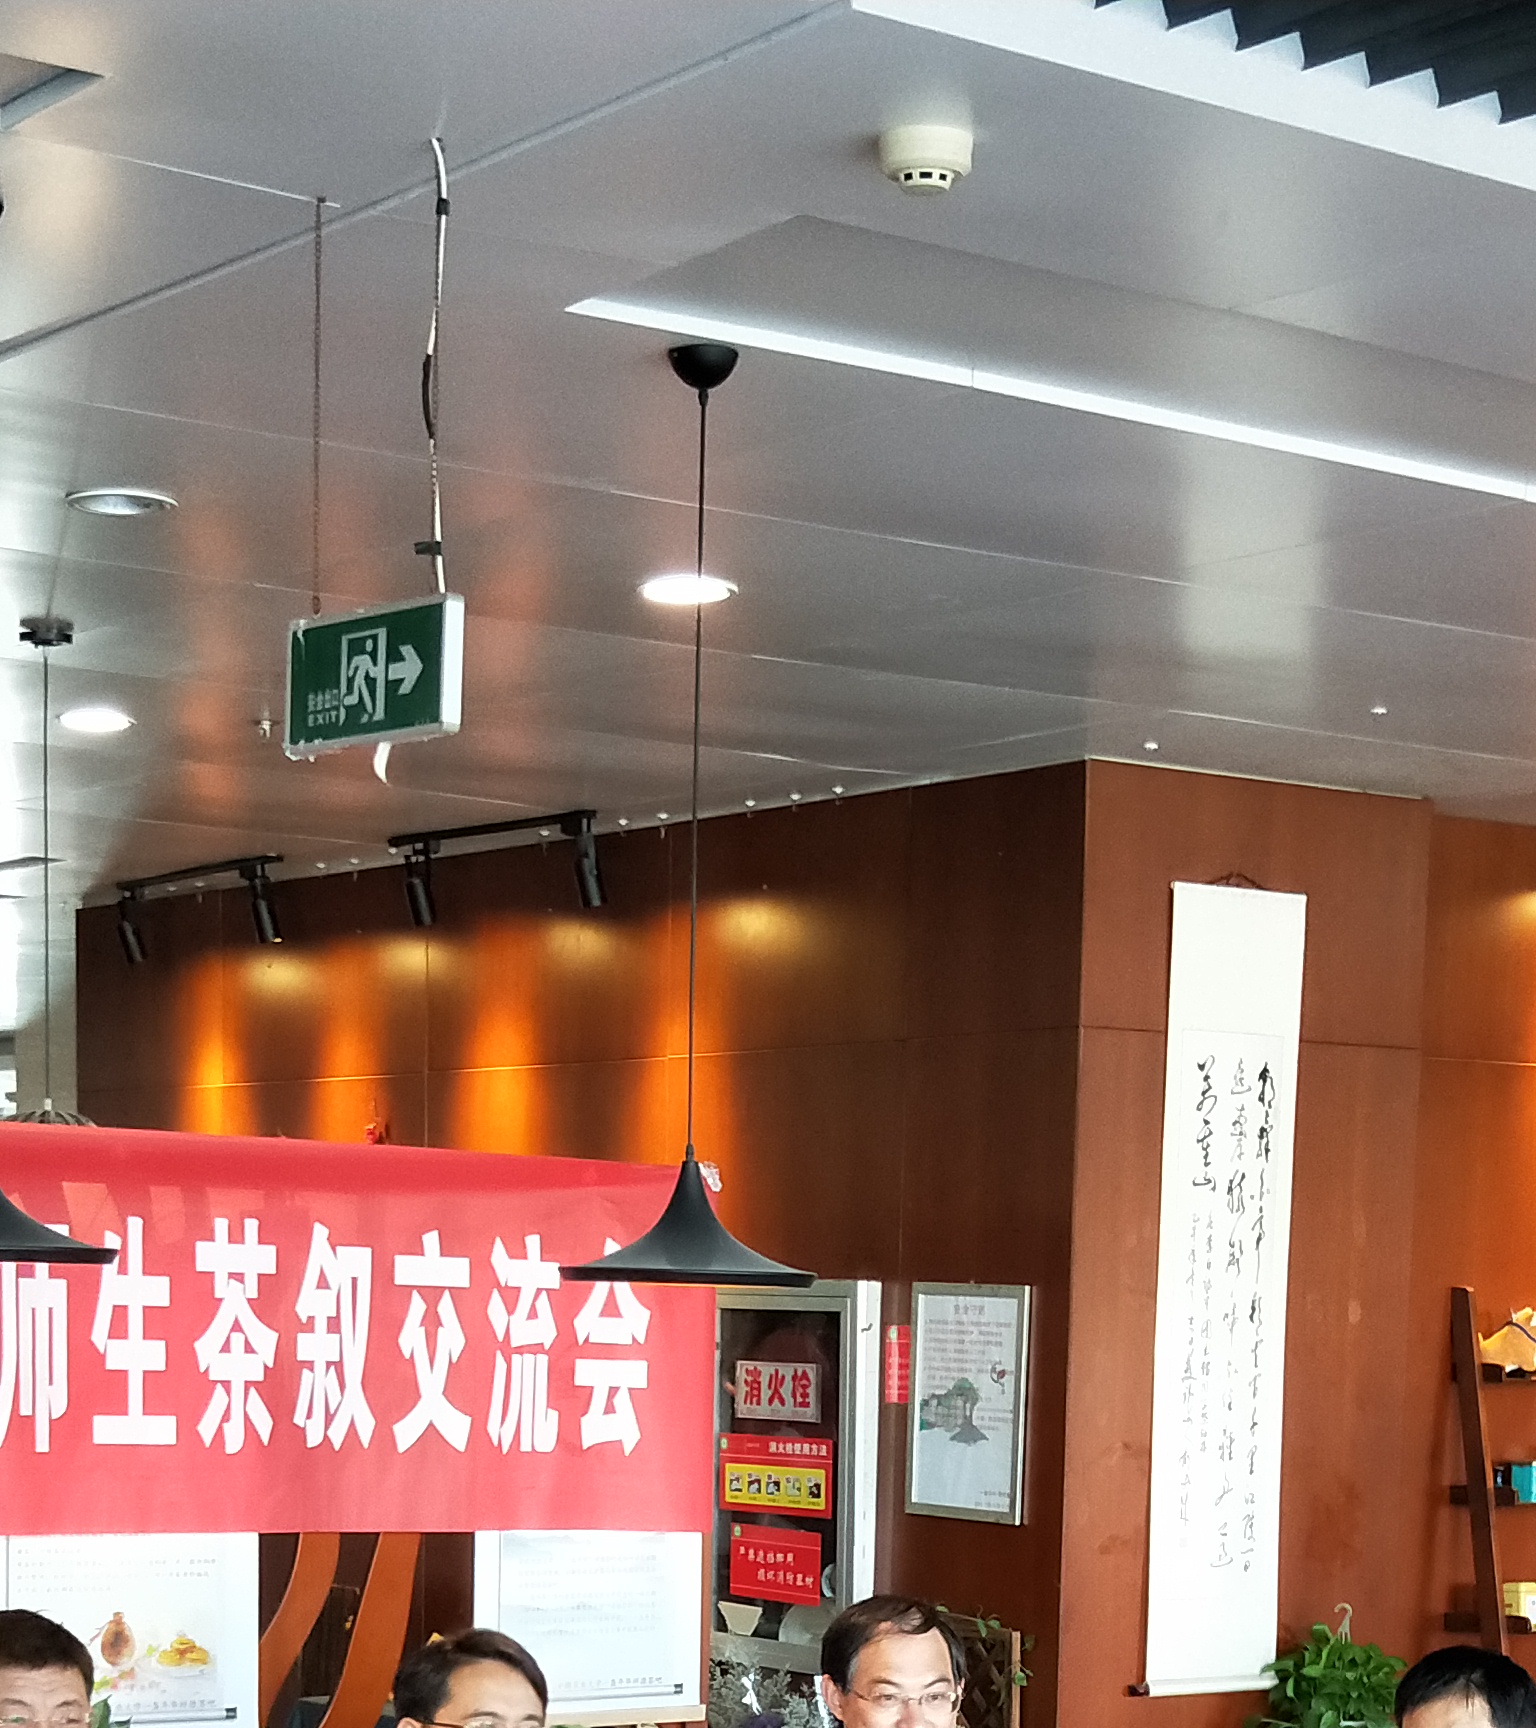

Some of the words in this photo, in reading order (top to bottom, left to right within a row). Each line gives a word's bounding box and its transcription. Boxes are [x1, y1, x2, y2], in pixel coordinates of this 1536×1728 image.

[308, 711, 337, 727] EXIT
[743, 1366, 812, 1409] 消火栓
[769, 1441, 828, 1457] 消火栓使用方法
